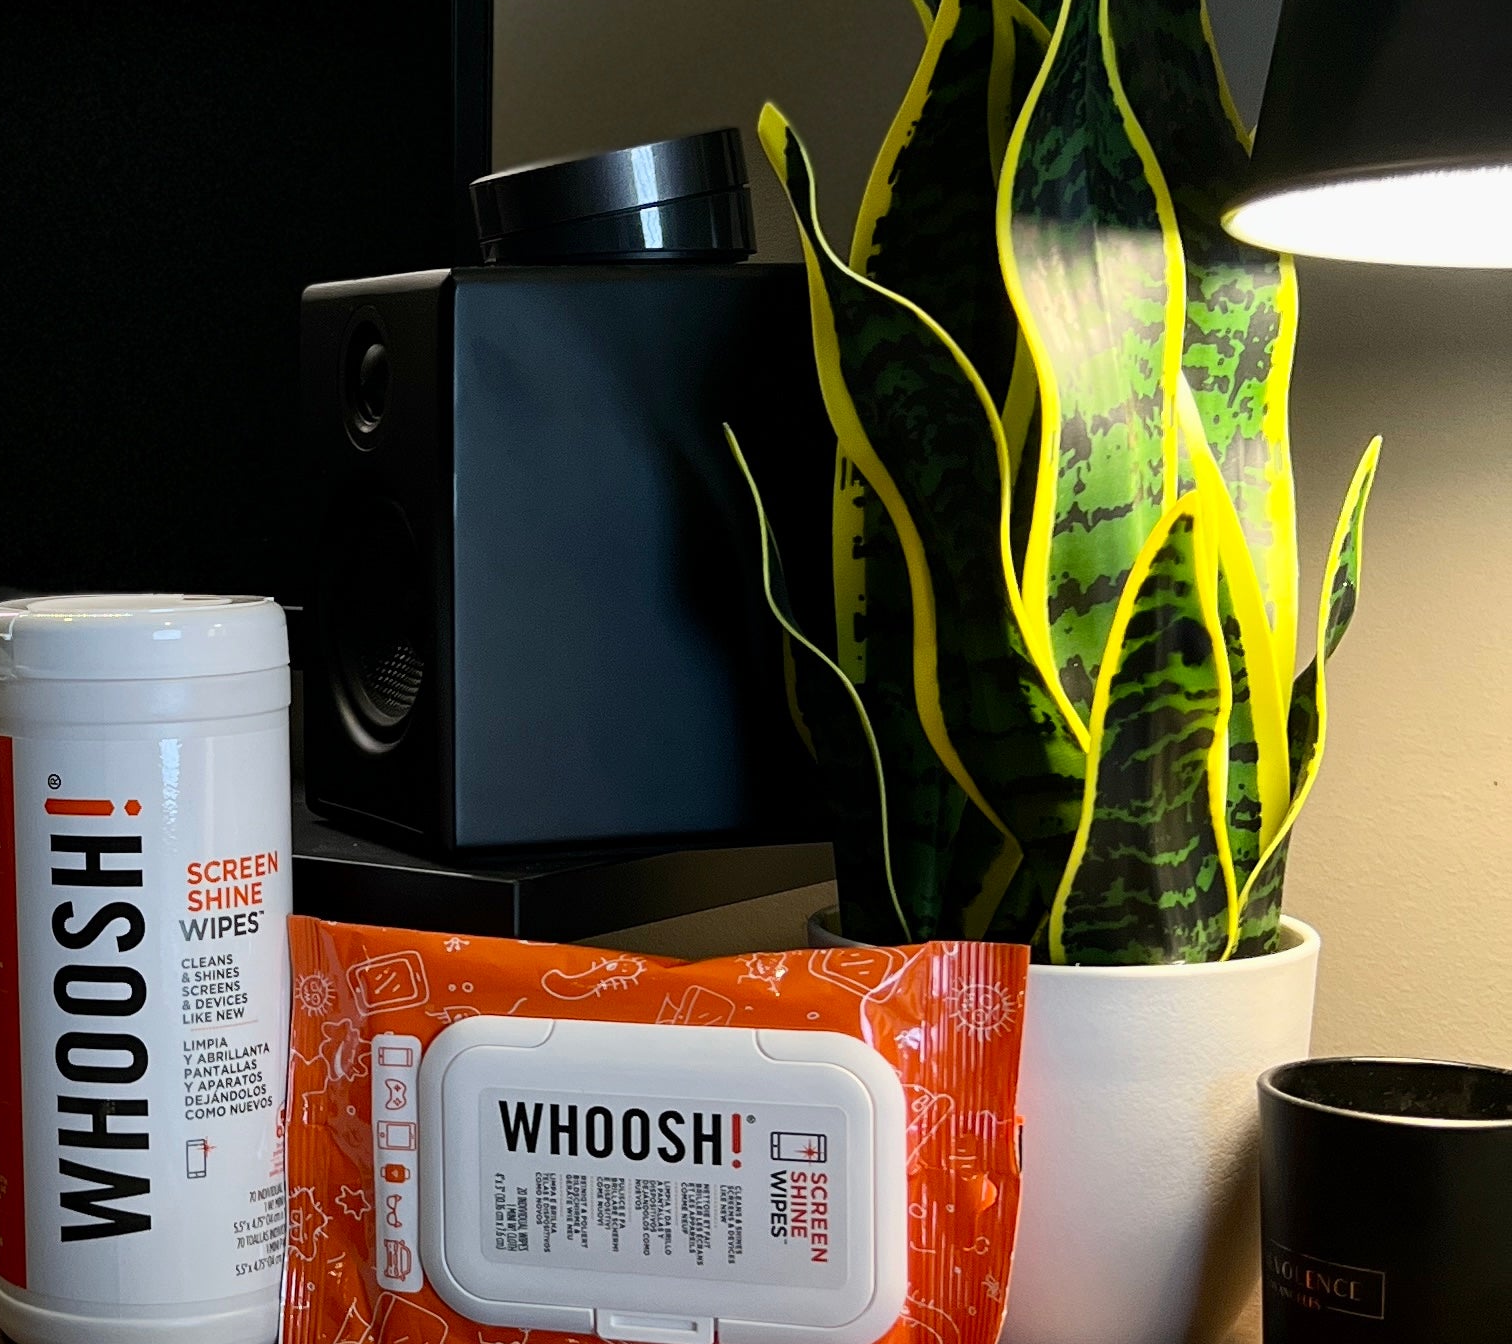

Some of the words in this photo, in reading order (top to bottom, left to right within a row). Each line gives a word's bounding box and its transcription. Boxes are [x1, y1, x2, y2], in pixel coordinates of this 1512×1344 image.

[187, 850, 278, 885] SCREEN
[187, 882, 263, 912] SHINE
[181, 954, 233, 969] CLEANS
[181, 972, 190, 983] &
[194, 967, 240, 982] SHINES
[182, 980, 241, 997] SCREENS
[182, 1000, 191, 1011] &
[195, 993, 248, 1010] DEVICES
[183, 1011, 212, 1024] LIKE
[216, 1007, 245, 1022] NEW
[183, 1037, 228, 1051] LIMPIA
[183, 1054, 193, 1066] Y
[197, 1042, 270, 1064] ABRILLANTA
[184, 1059, 257, 1079] PANTALLAS
[184, 1081, 194, 1093] Y
[198, 1071, 263, 1092] APARATOS
[185, 1084, 267, 1106] DEJÁNDOLOS
[185, 1106, 226, 1120] COMO
[230, 1096, 273, 1116] NUEVOS
[790, 1171, 809, 1239] SHINE
[810, 1172, 828, 1264] SCREEN
